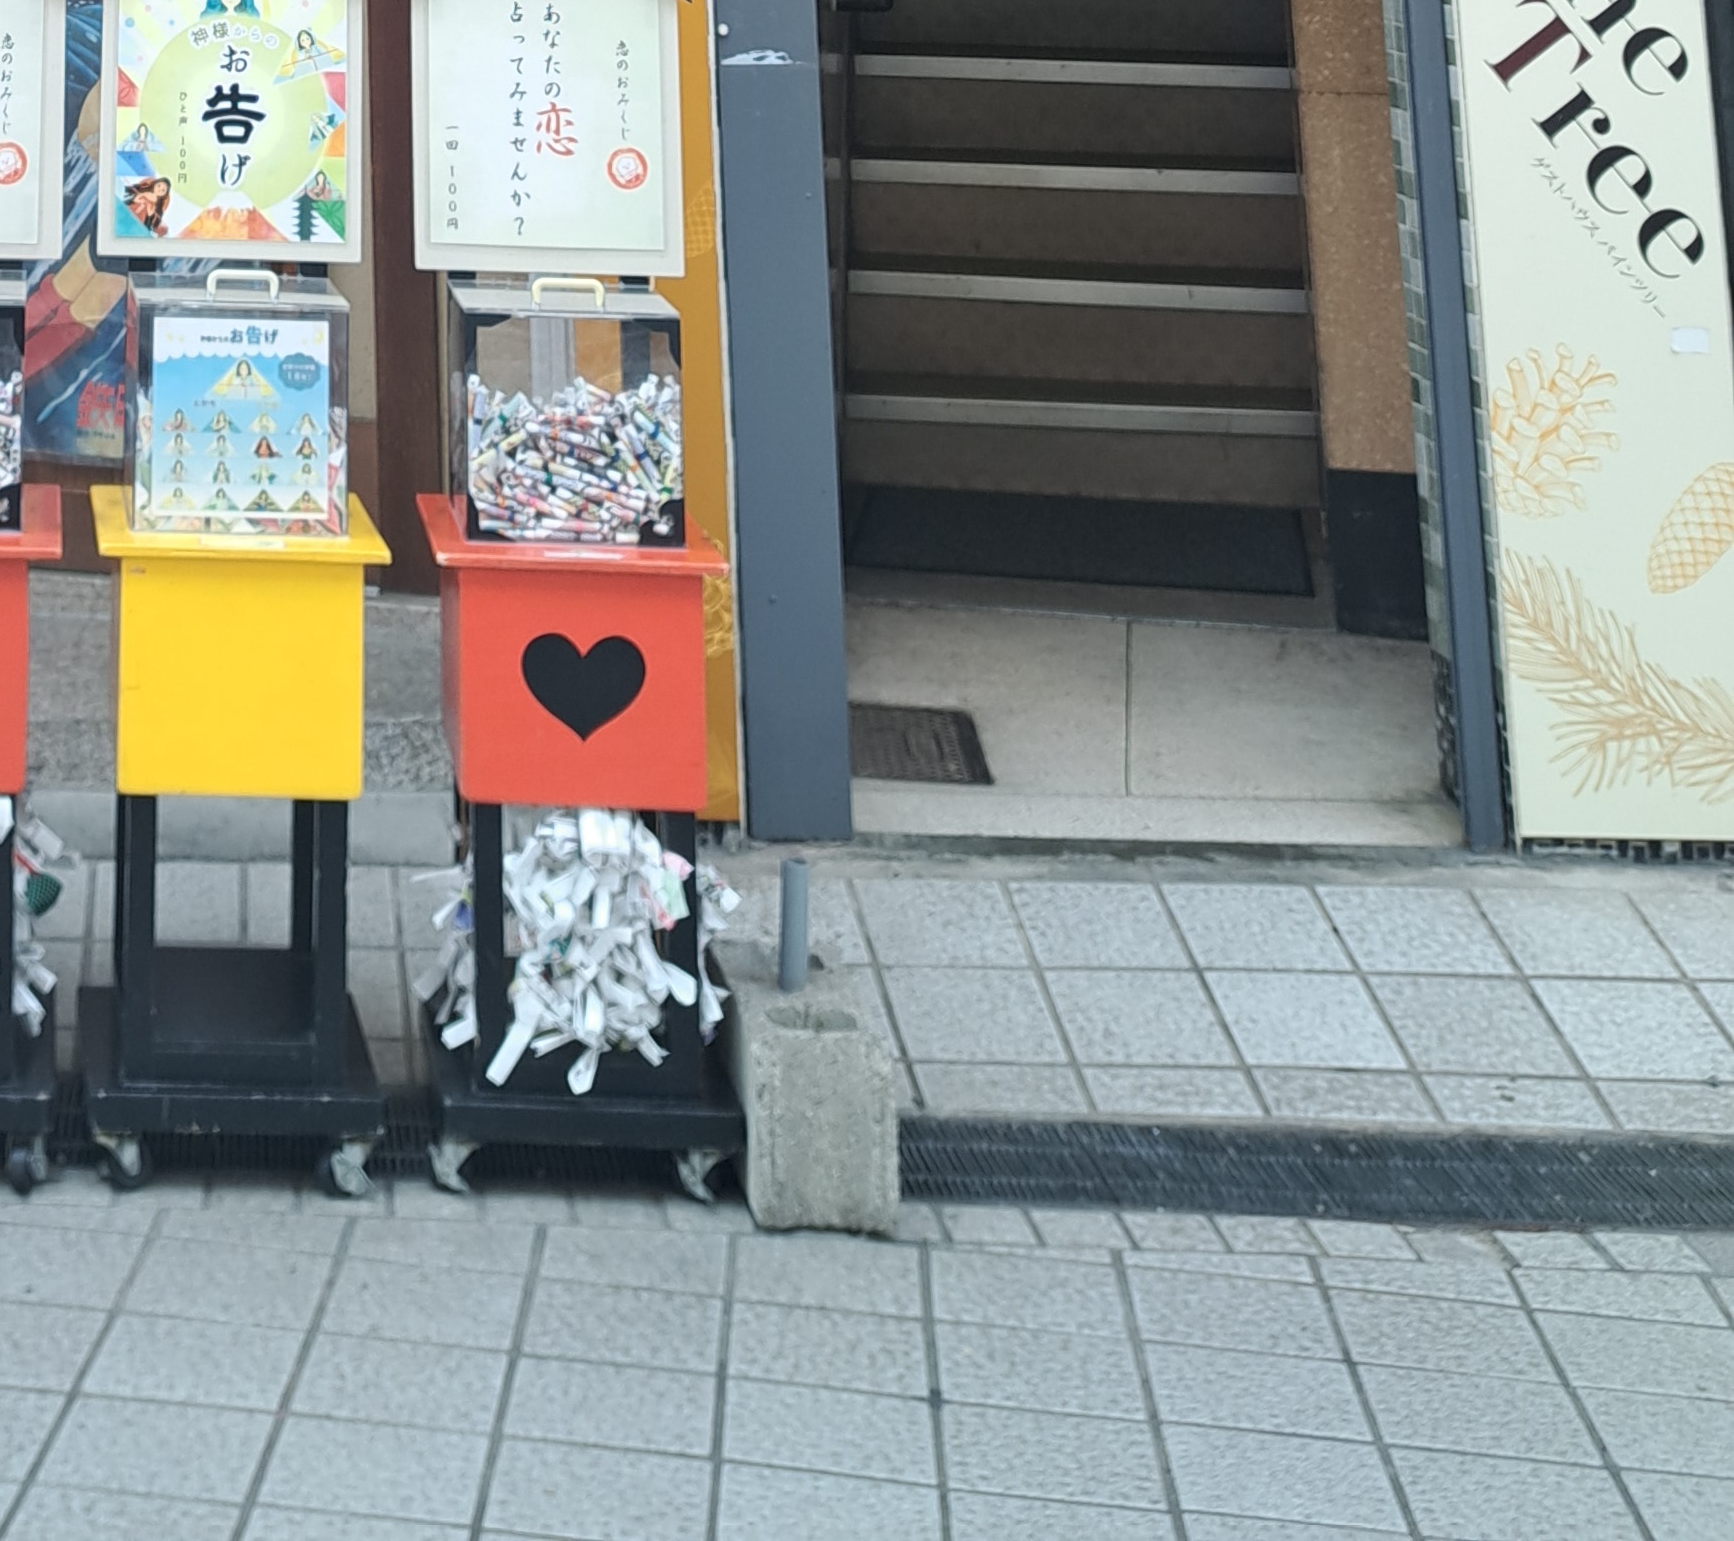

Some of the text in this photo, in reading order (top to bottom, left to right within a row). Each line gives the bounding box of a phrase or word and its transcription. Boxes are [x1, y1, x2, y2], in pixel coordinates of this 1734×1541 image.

[0, 32, 16, 135] 恋のおみくじ
[191, 21, 279, 47] 神様からの
[536, 3, 579, 157] あなたの恋
[201, 44, 267, 186] お告げ
[509, 1, 531, 236] 占ってみませんか？
[615, 39, 630, 141] 恋のおみくじ
[1530, 157, 1601, 239] ゲストハウス
[229, 325, 279, 345] お告げ
